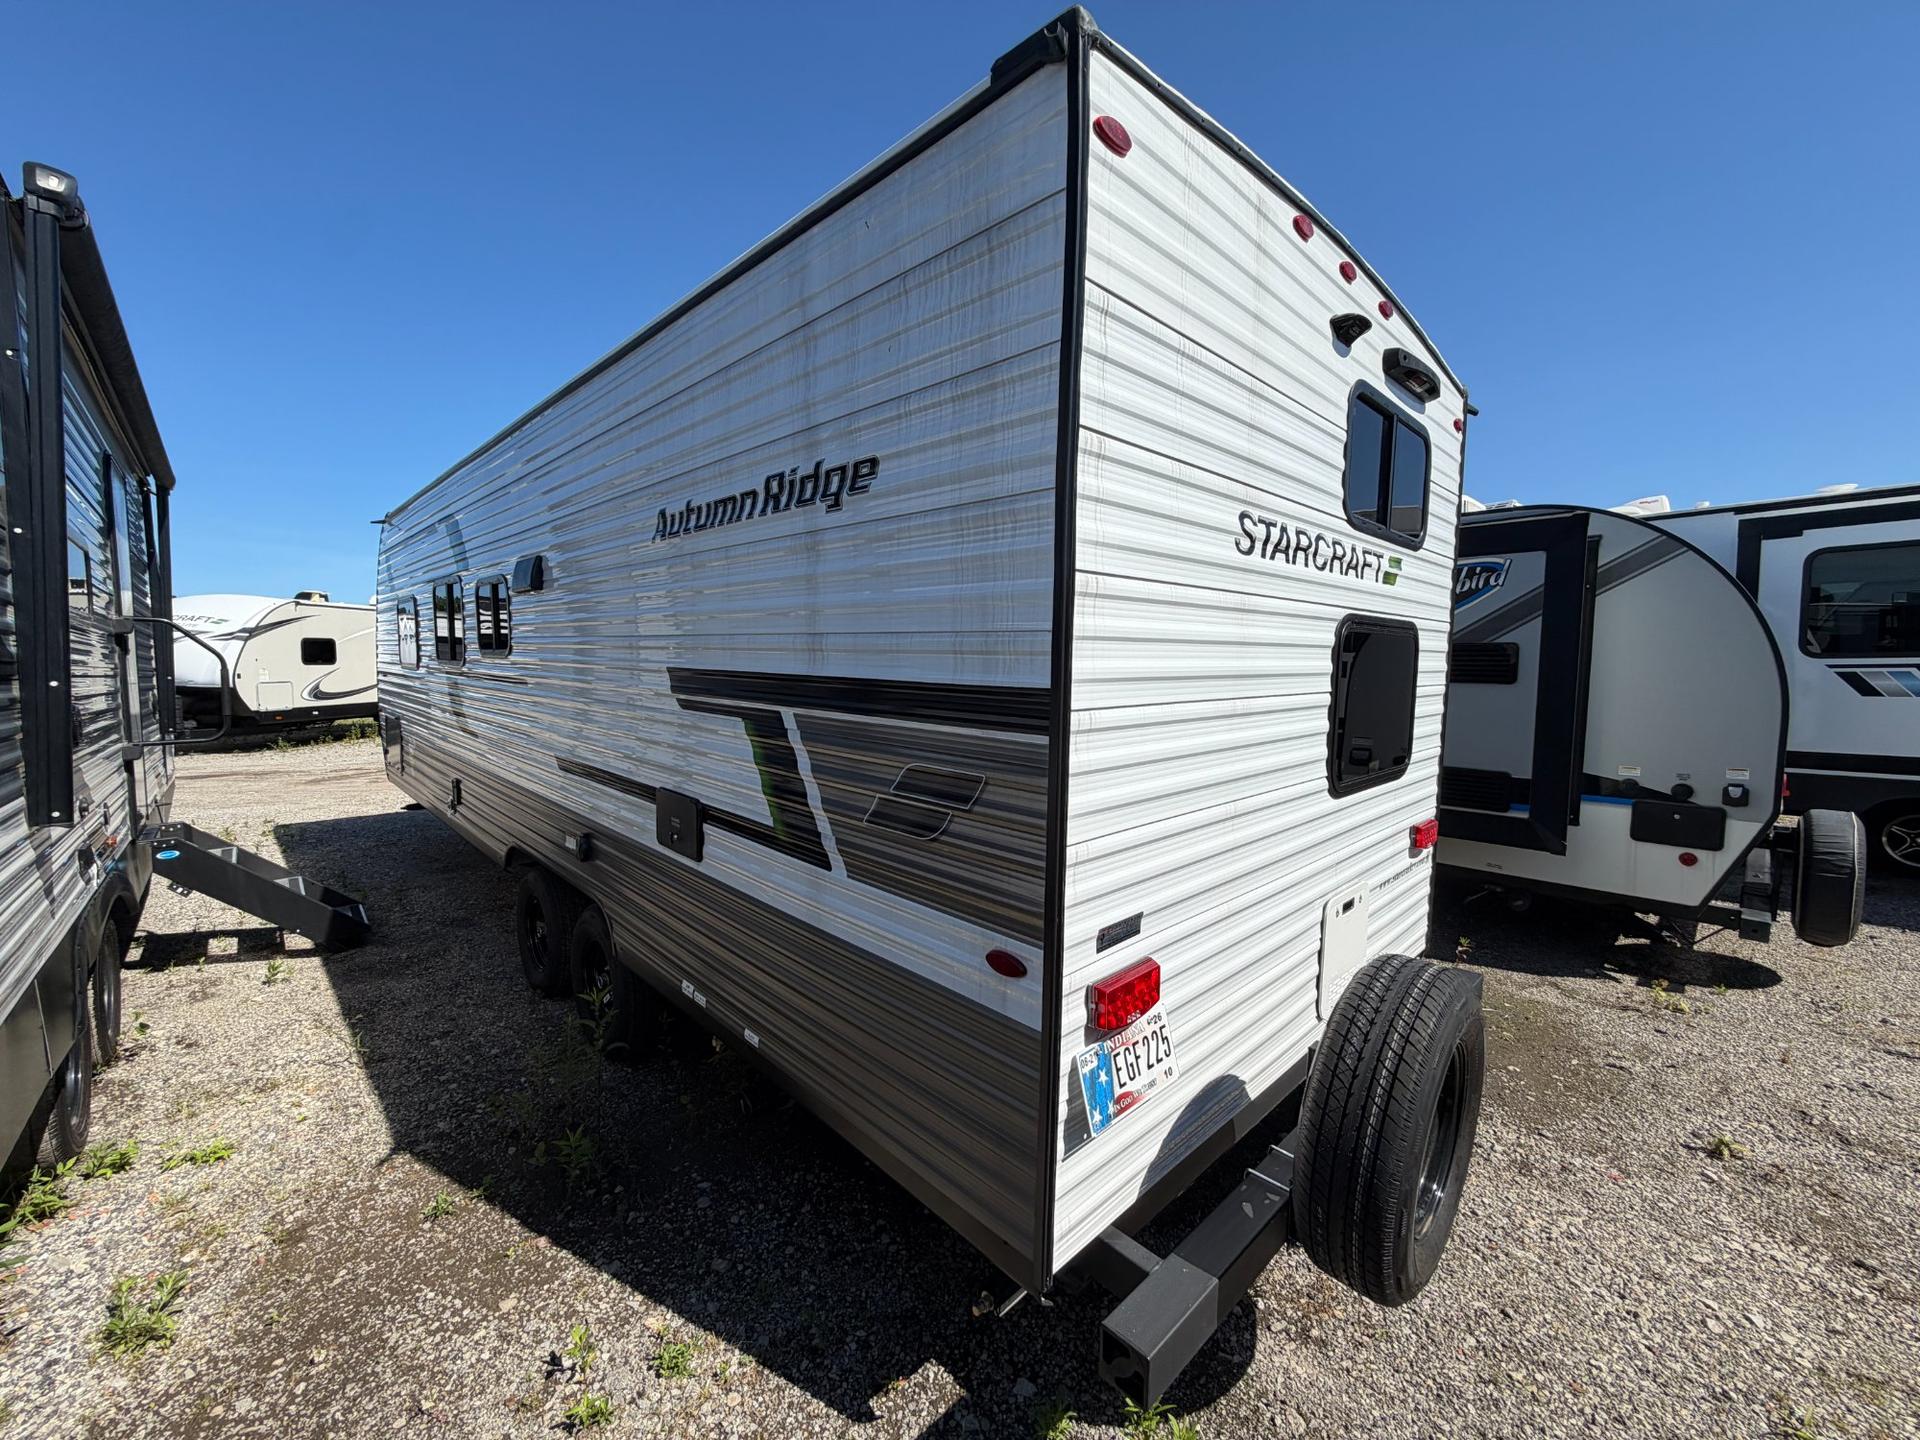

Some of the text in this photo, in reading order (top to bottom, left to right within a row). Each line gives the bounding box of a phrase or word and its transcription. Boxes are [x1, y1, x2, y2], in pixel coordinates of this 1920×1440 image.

[651, 454, 880, 544] Autumn Ridge
[1234, 510, 1384, 583] STARCRAFT
[1456, 558, 1512, 594] bird
[1104, 1020, 1145, 1054] INDIANA
[1113, 1024, 1171, 1089] EGF225
[1164, 1066, 1173, 1079] 10
